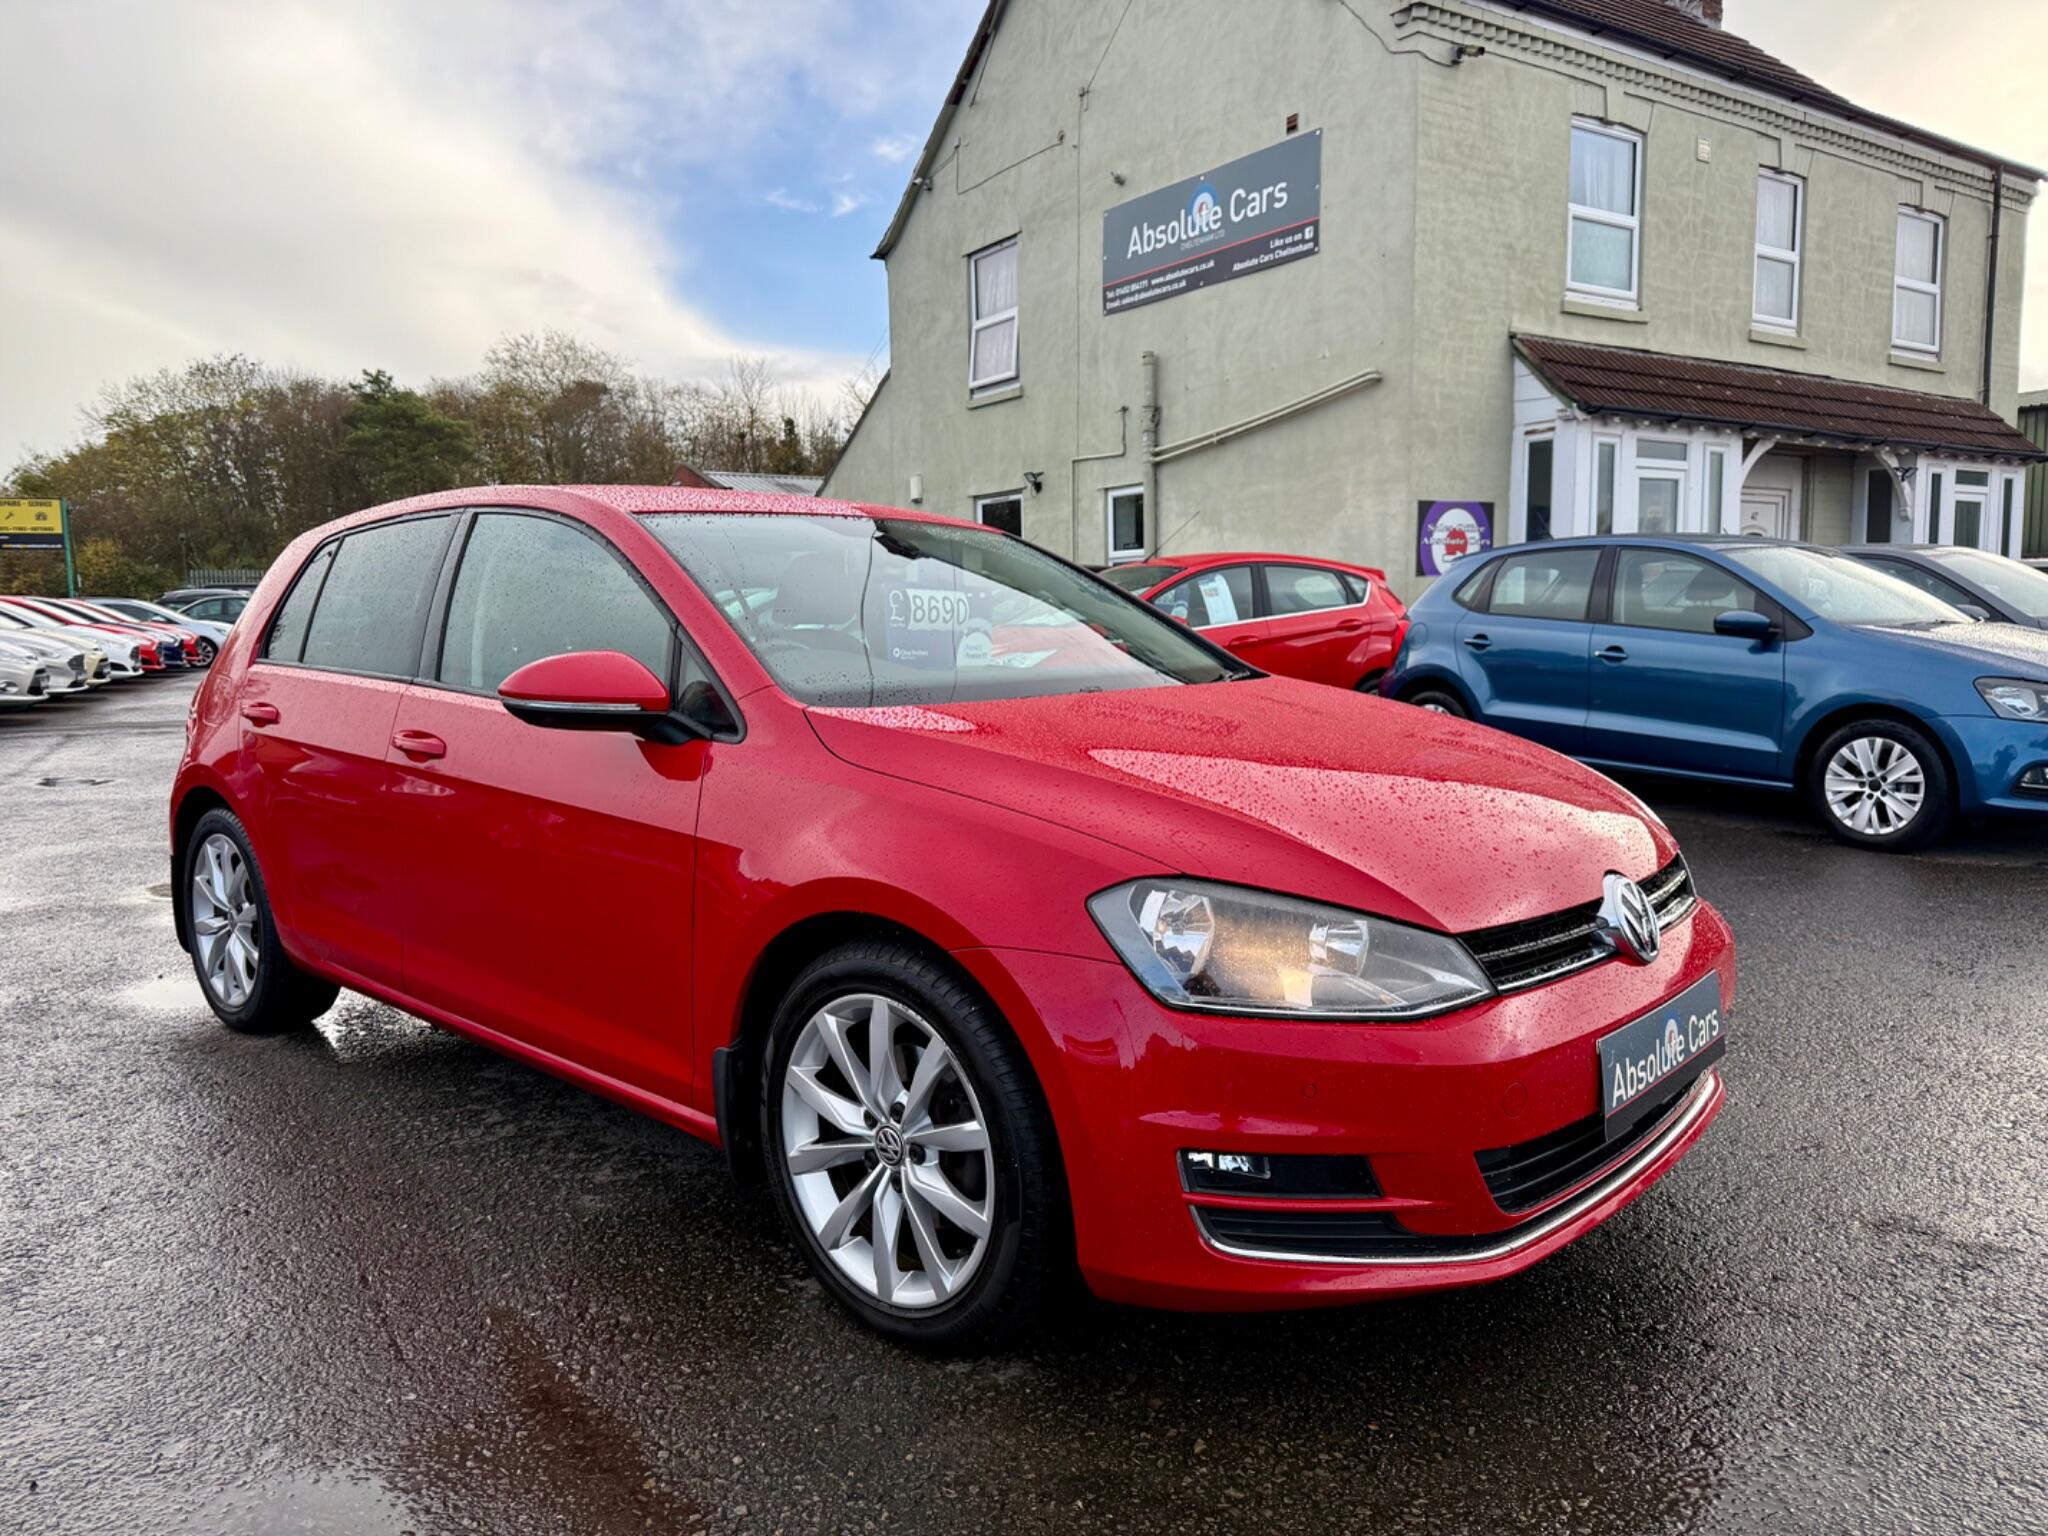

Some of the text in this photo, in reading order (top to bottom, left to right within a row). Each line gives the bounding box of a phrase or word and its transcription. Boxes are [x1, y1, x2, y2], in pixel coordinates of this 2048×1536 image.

[1127, 182, 1288, 259] Absolute Cars
[1269, 238, 1284, 249] Like
[1285, 235, 1293, 244] us
[1293, 232, 1303, 242] on
[1232, 242, 1315, 272] Absolute Cars Cheltenham
[1612, 1008, 1719, 1109] Absolute Cars
